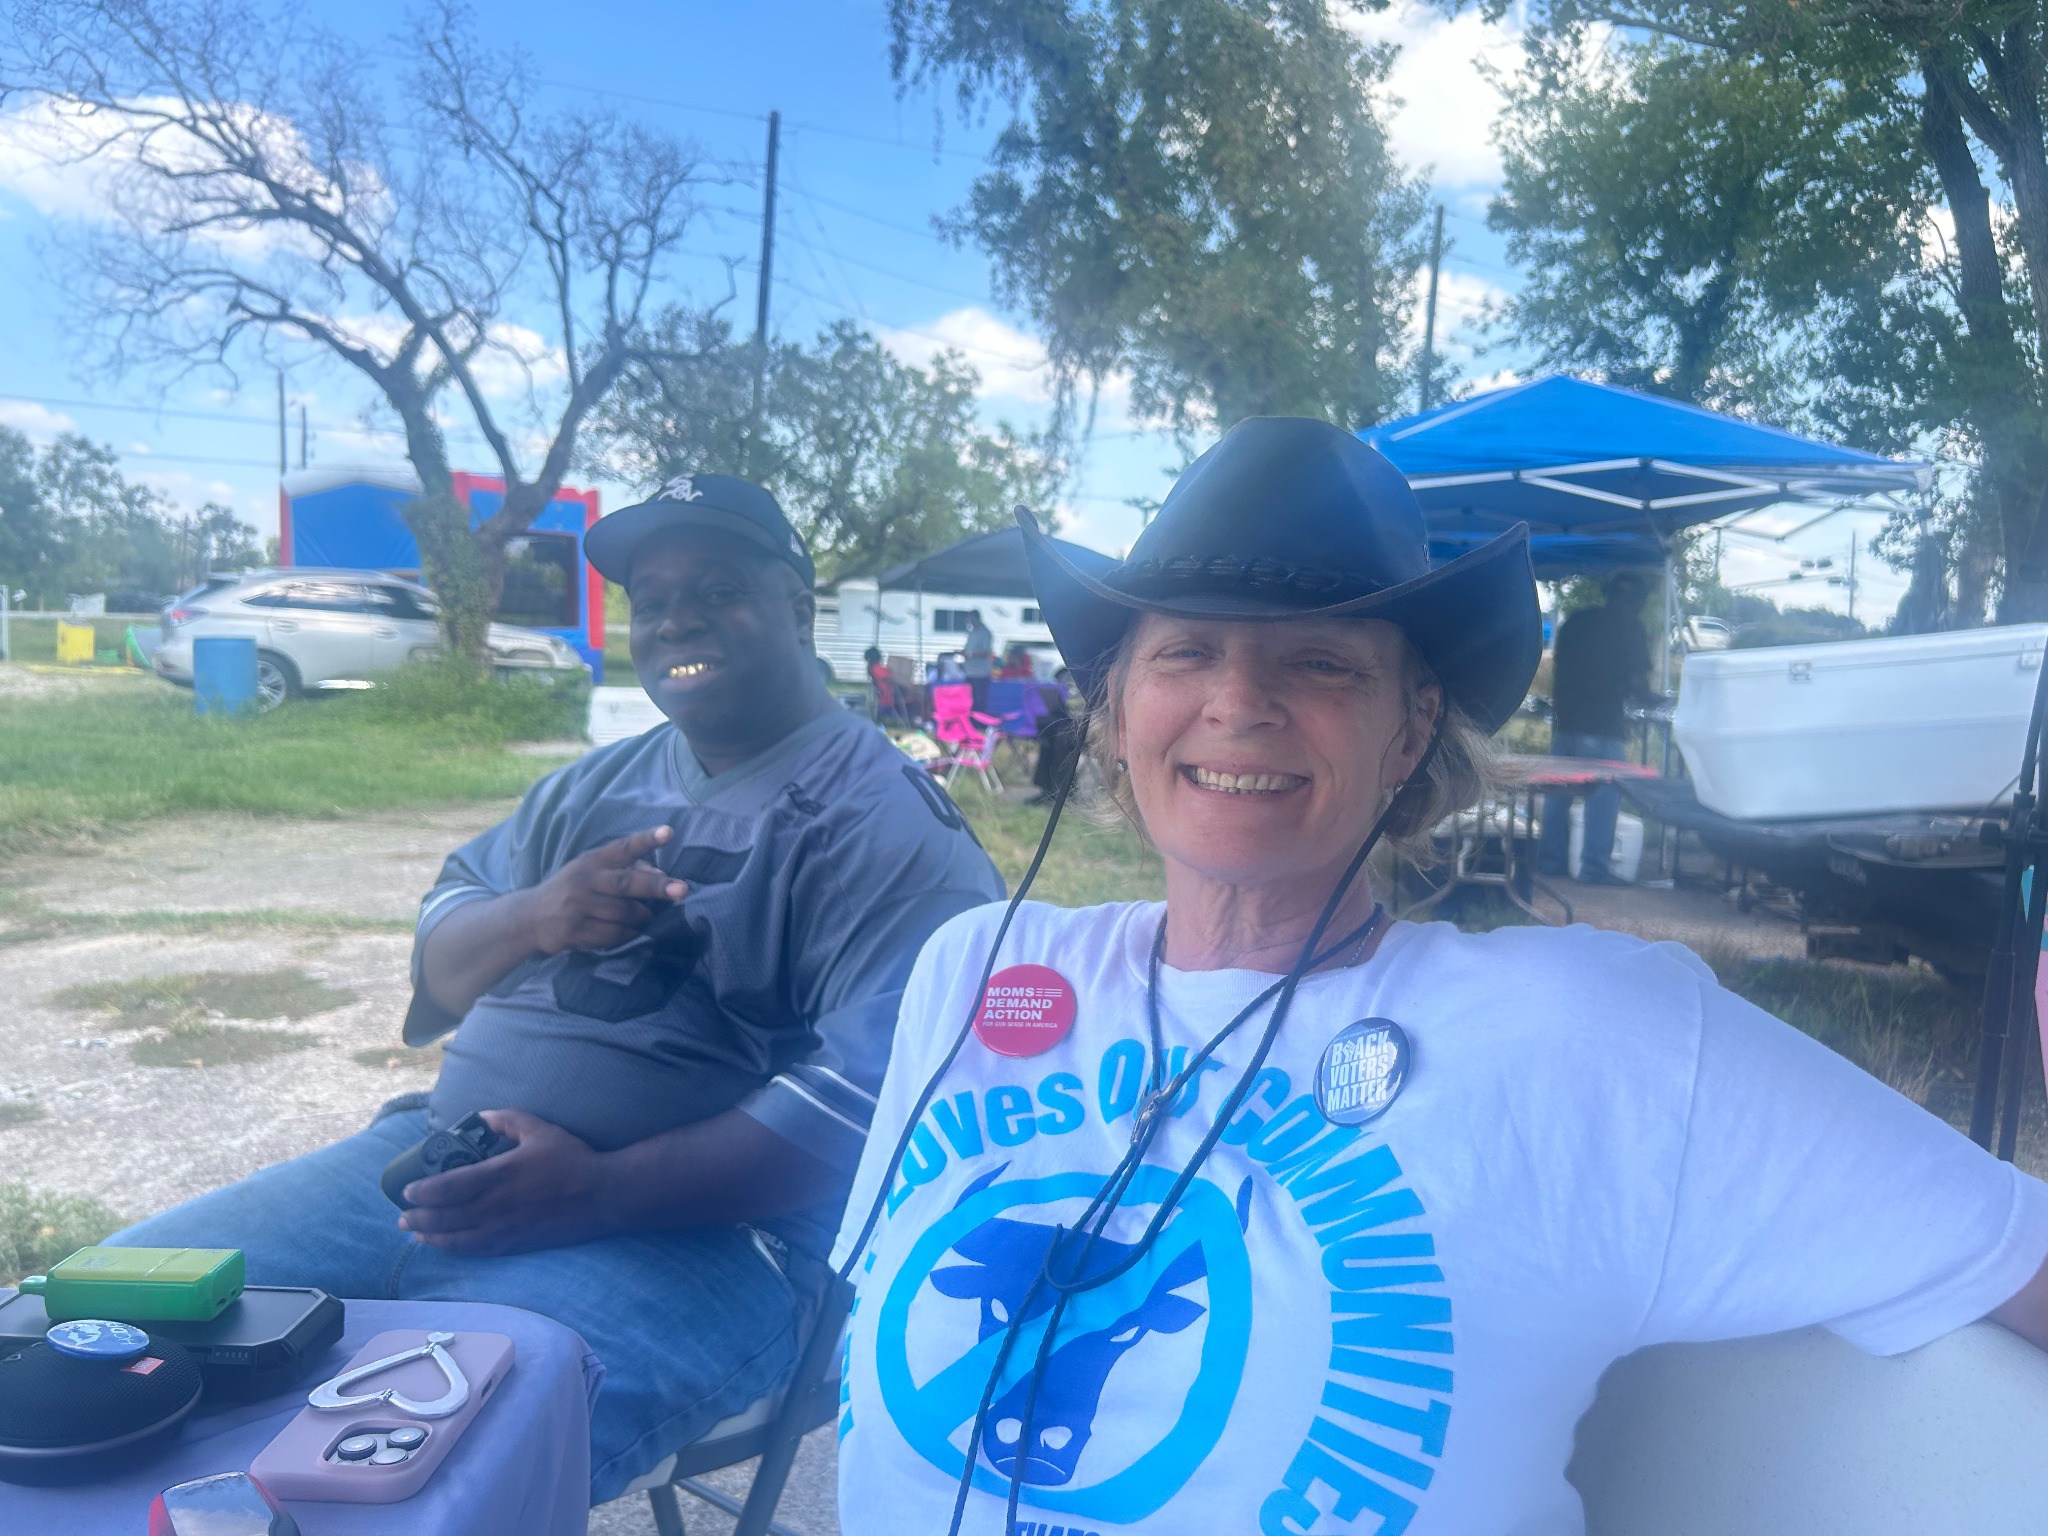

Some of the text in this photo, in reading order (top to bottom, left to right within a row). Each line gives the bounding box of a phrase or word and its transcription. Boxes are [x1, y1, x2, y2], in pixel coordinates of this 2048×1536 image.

[985, 998, 1053, 1009] DEMAND
[987, 987, 1035, 997] MOMS
[983, 1009, 1042, 1020] ACTION
[1330, 1054, 1389, 1089] VOTERS
[1327, 1075, 1389, 1113] MATTER
[886, 1071, 1085, 1221] oves
